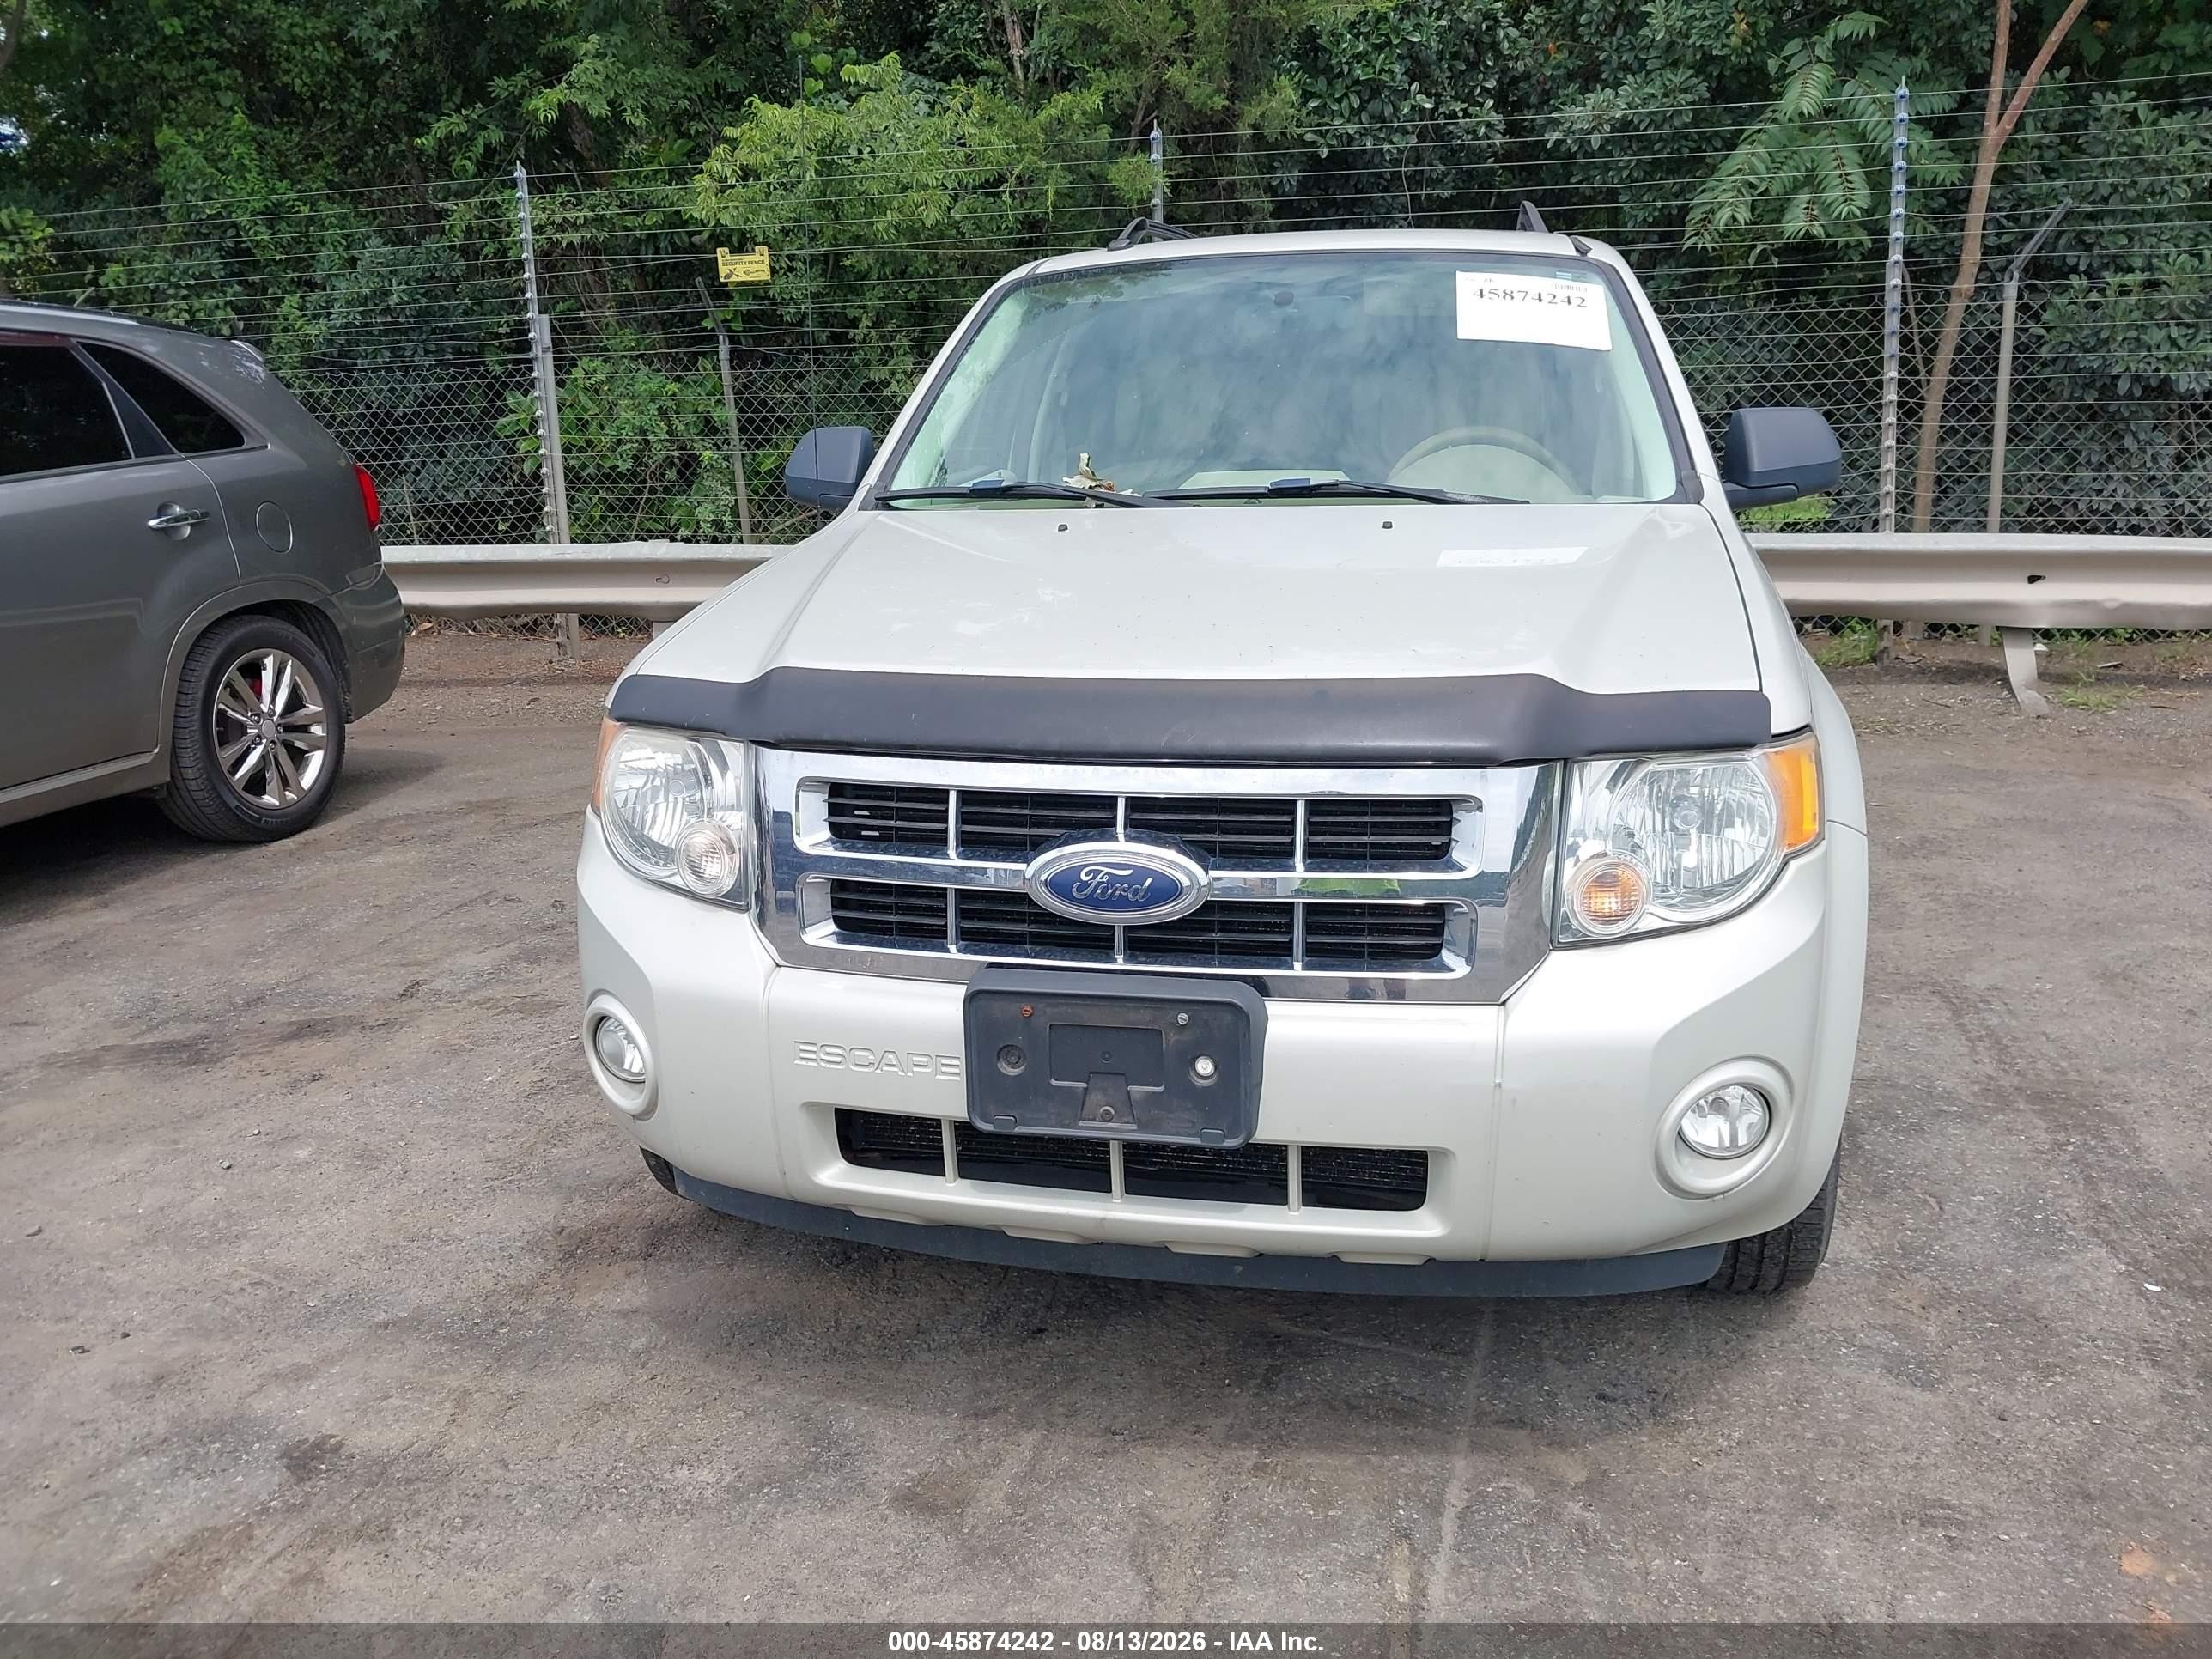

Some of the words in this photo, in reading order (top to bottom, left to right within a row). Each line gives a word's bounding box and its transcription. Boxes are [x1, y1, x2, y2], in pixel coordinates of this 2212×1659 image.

[1472, 287, 1588, 308] 45874242
[1072, 866, 1153, 902] Ford
[793, 1040, 962, 1081] ESCAPE
